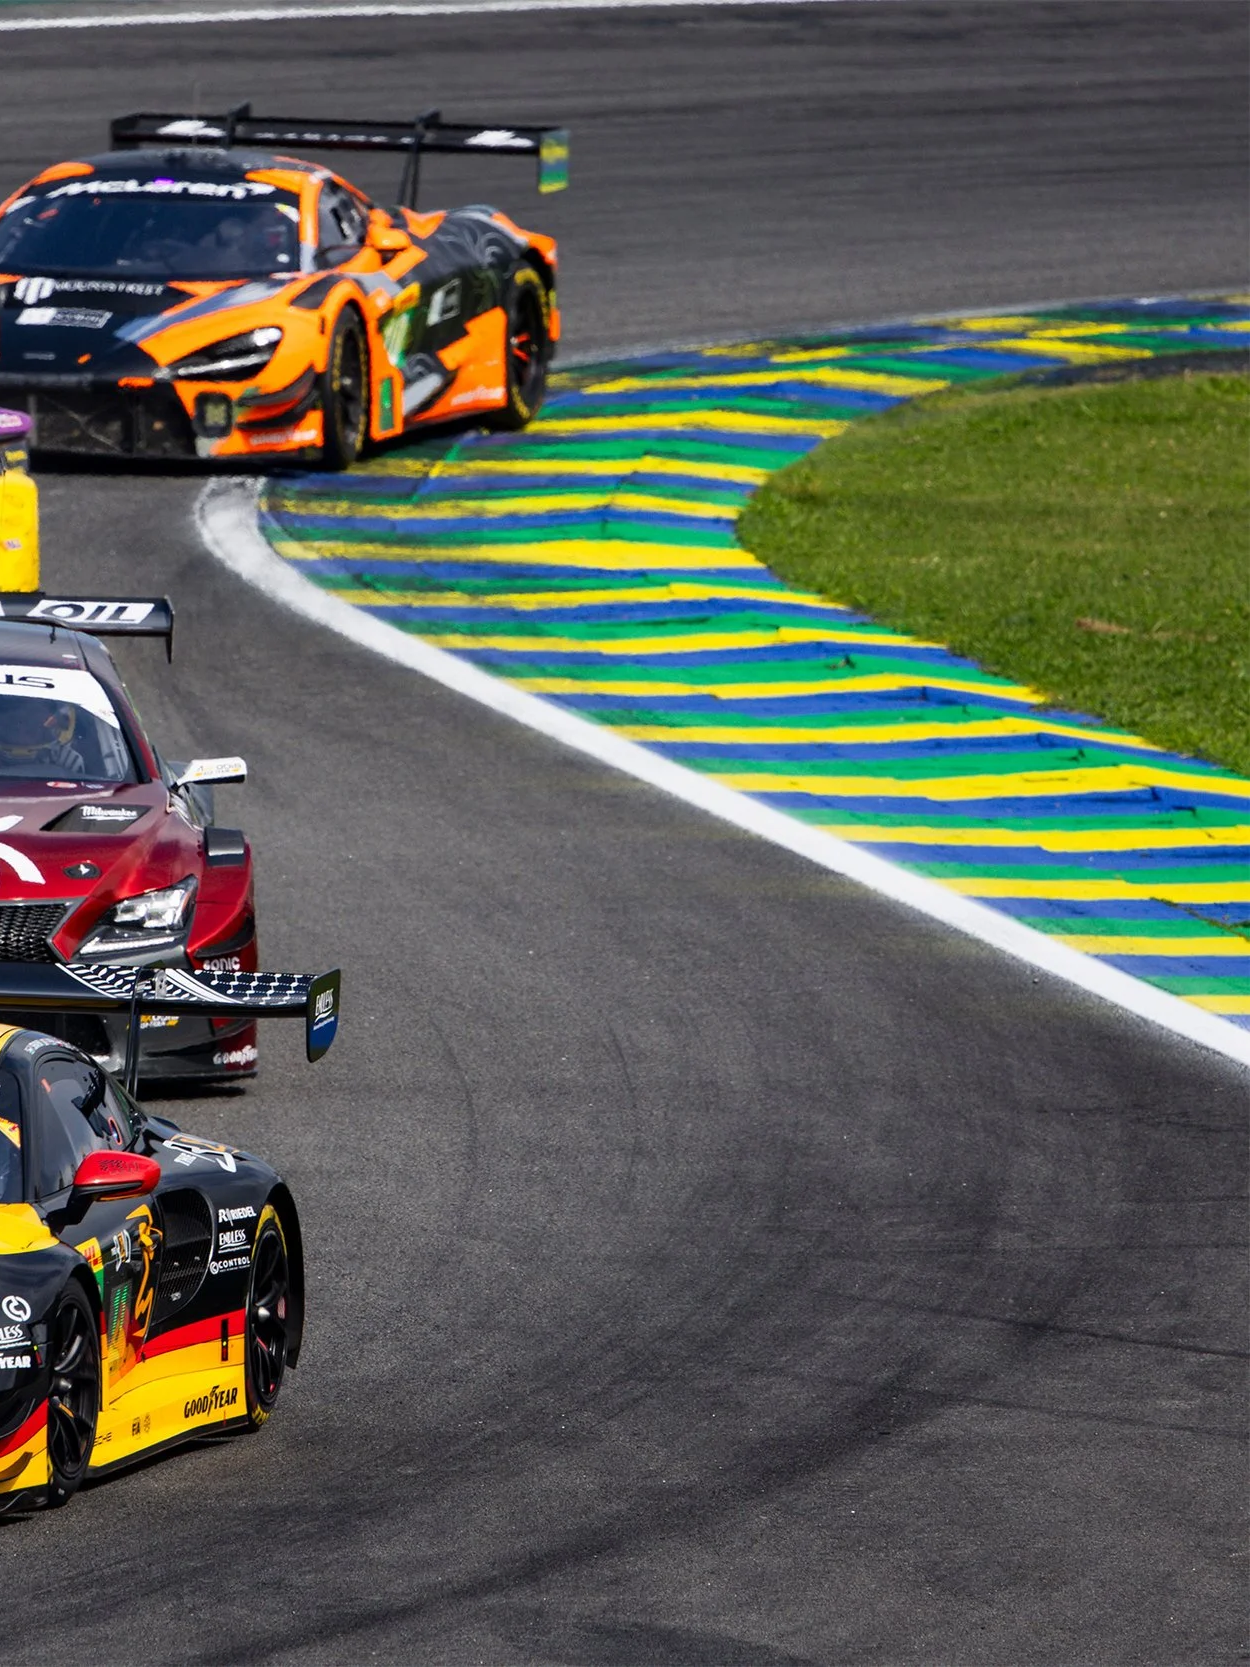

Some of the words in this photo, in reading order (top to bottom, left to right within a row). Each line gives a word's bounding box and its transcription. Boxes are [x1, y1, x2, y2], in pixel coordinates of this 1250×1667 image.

[47, 179, 255, 200] McLaren
[41, 603, 139, 622] OIL
[80, 805, 138, 818] Milwaukee
[203, 956, 241, 971] SONIC
[219, 1229, 247, 1246] ENDLESS
[218, 1256, 251, 1269] CONTROL
[184, 1385, 238, 1419] GOODYEAR
